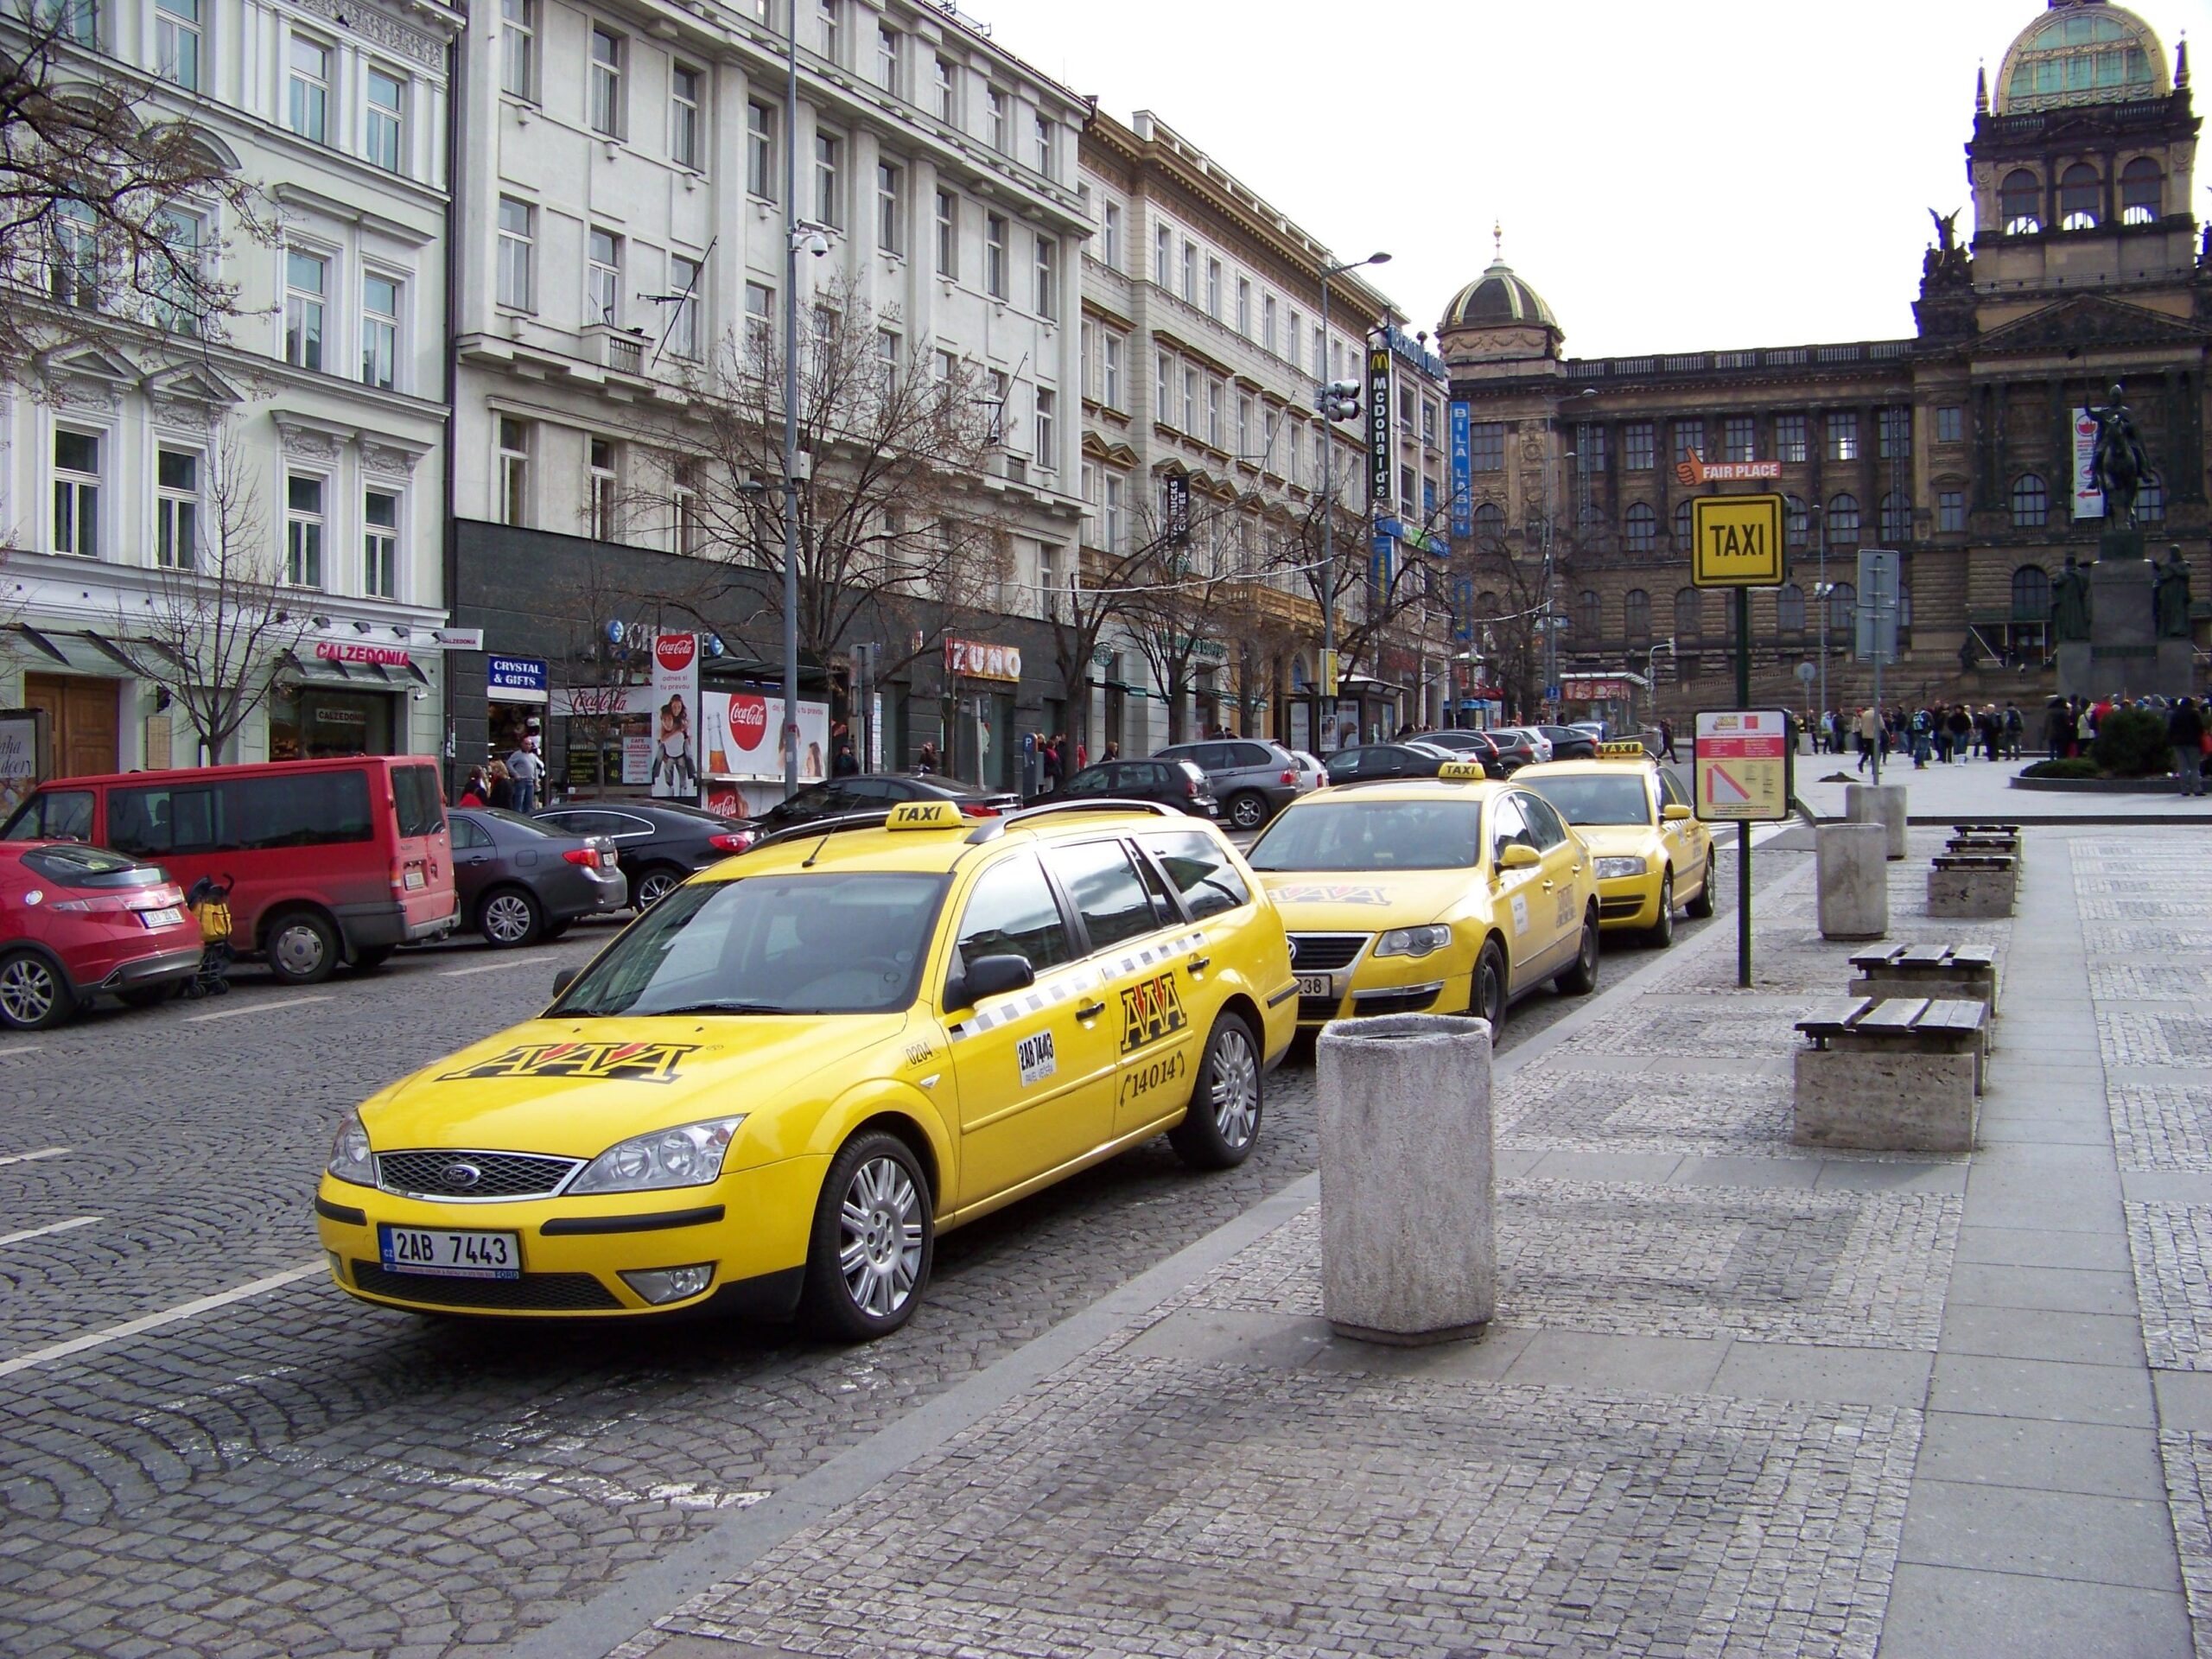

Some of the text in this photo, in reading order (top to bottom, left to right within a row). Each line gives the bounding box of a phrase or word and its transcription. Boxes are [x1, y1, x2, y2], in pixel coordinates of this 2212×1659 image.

[1373, 377, 1389, 497] McDonald's
[1453, 408, 1467, 457] BÍLÁ
[1703, 464, 1777, 479] FAIR PLACE
[1709, 524, 1764, 556] TAXI
[316, 642, 410, 667] CALZEDONIA
[952, 643, 1021, 677] ZUNO
[493, 660, 541, 674] CRYSTAL
[493, 674, 536, 686] & GIFTS
[1025, 737, 1032, 747] P
[1601, 744, 1633, 753] TAXI
[1446, 765, 1476, 775] TAXI
[899, 806, 942, 822] TAXI
[1121, 971, 1188, 1055] AAA
[906, 1041, 933, 1065] 0204
[1019, 1042, 1035, 1071] 2AB
[1132, 1056, 1175, 1098] 14014
[447, 1169, 468, 1181] Ford
[384, 1249, 393, 1257] CZ
[397, 1232, 507, 1264] 2AB 7443
